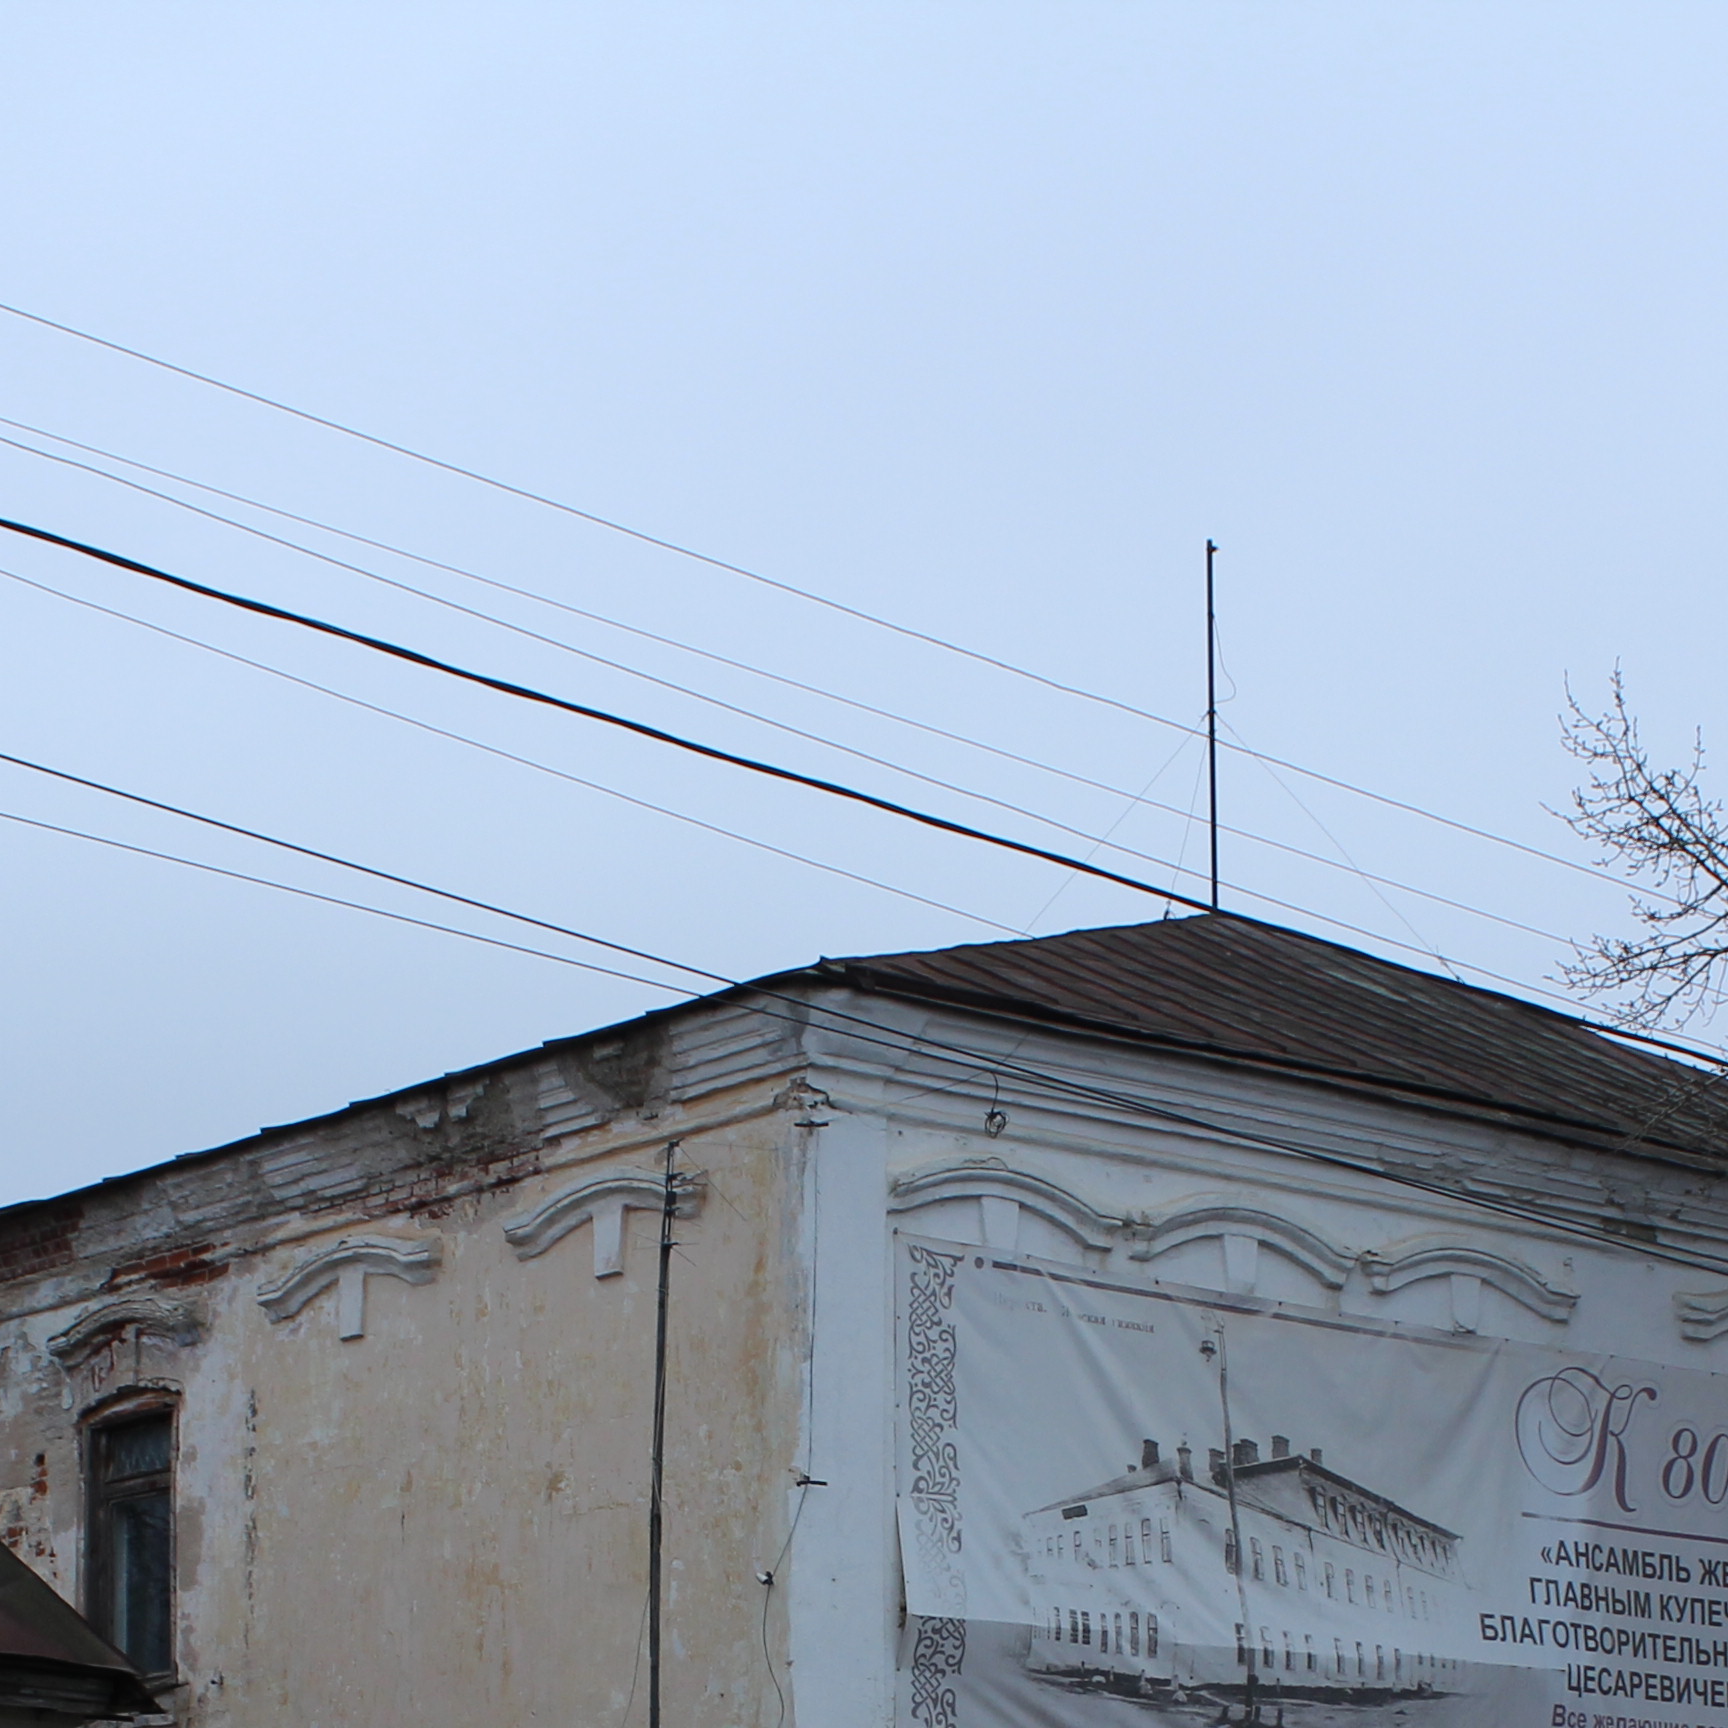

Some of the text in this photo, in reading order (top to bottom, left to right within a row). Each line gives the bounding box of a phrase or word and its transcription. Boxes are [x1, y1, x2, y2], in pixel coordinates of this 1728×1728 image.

[1515, 1366, 1658, 1514] К
[1540, 1539, 1692, 1583] «АНСАМБЛЬ
[1529, 1576, 1652, 1619] ГЛАВНЫМ
